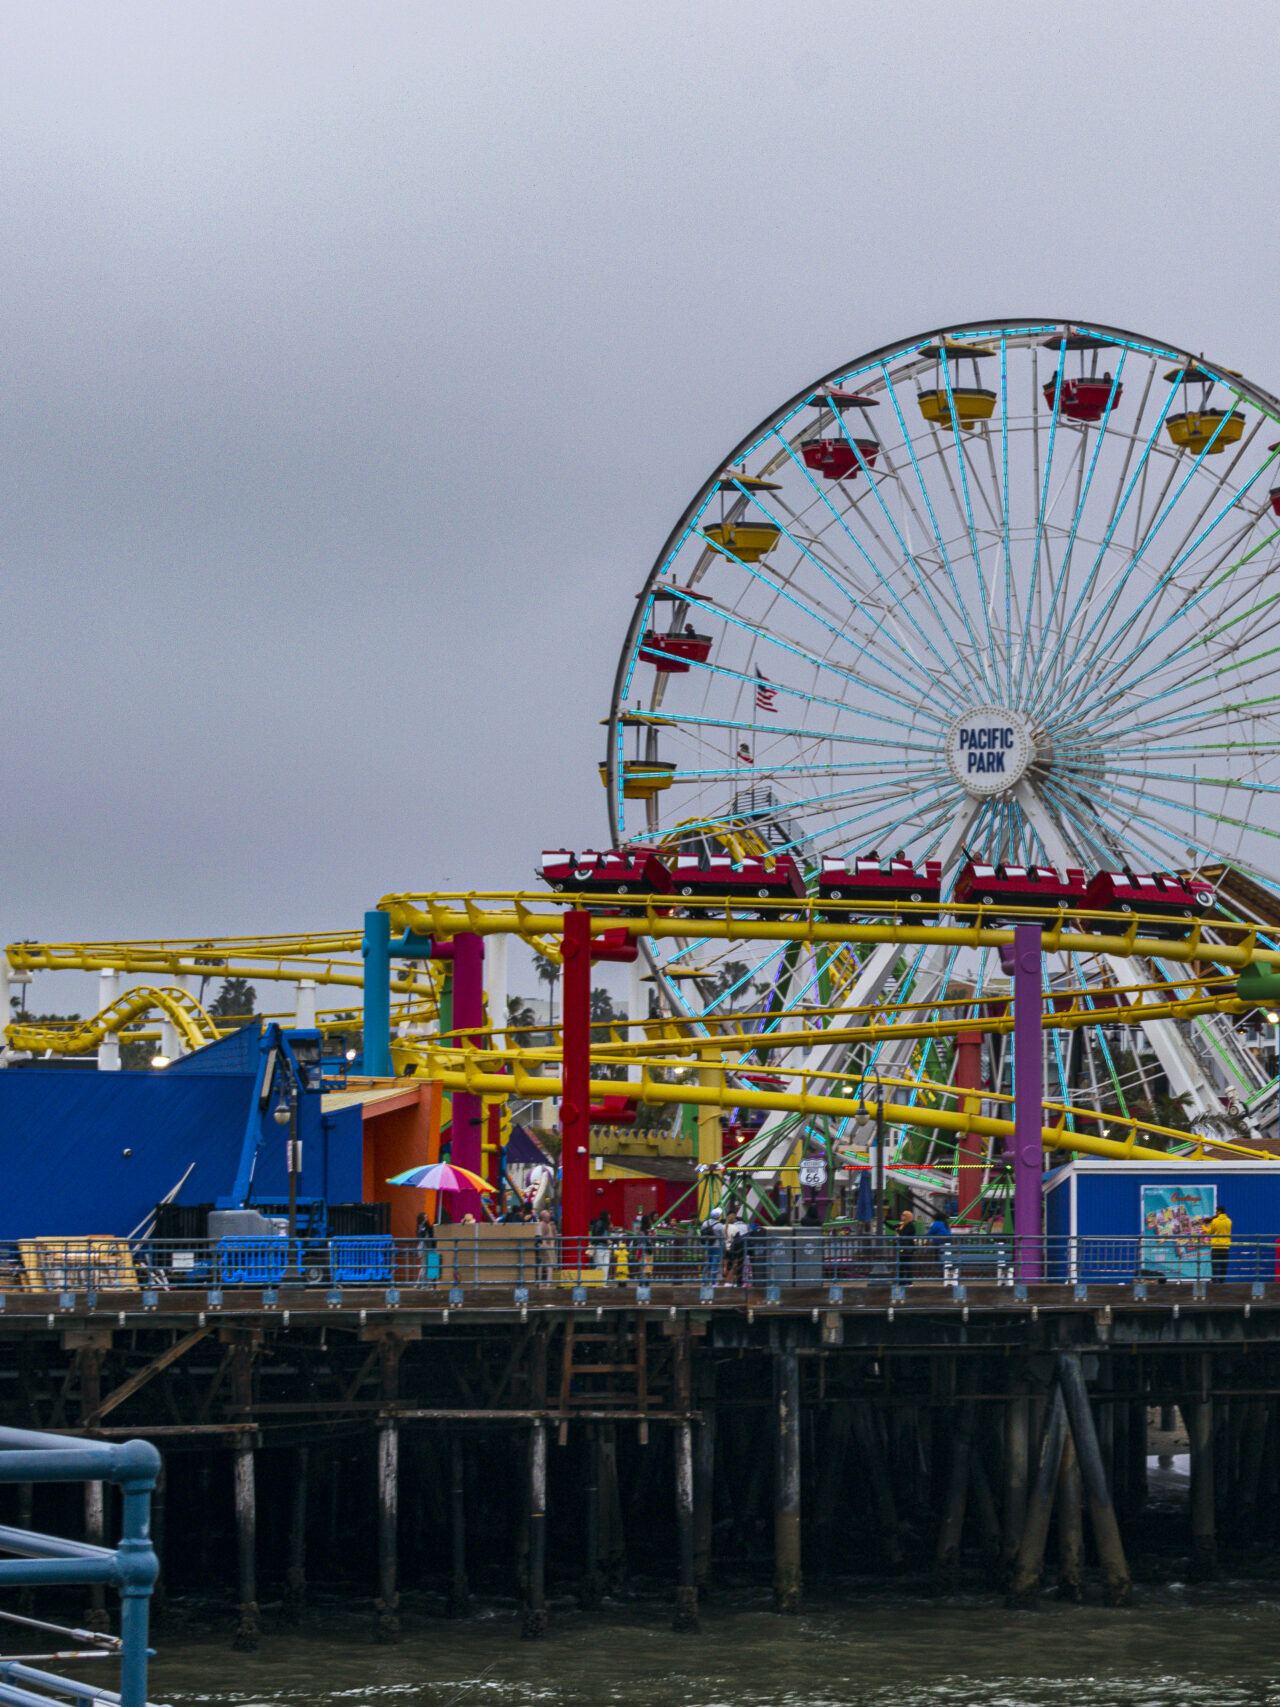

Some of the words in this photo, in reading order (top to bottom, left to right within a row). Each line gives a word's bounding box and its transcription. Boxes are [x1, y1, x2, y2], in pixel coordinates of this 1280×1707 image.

[959, 727, 1014, 750] PACIFIC
[967, 751, 1005, 773] PARK
[806, 1173, 820, 1183] 66
